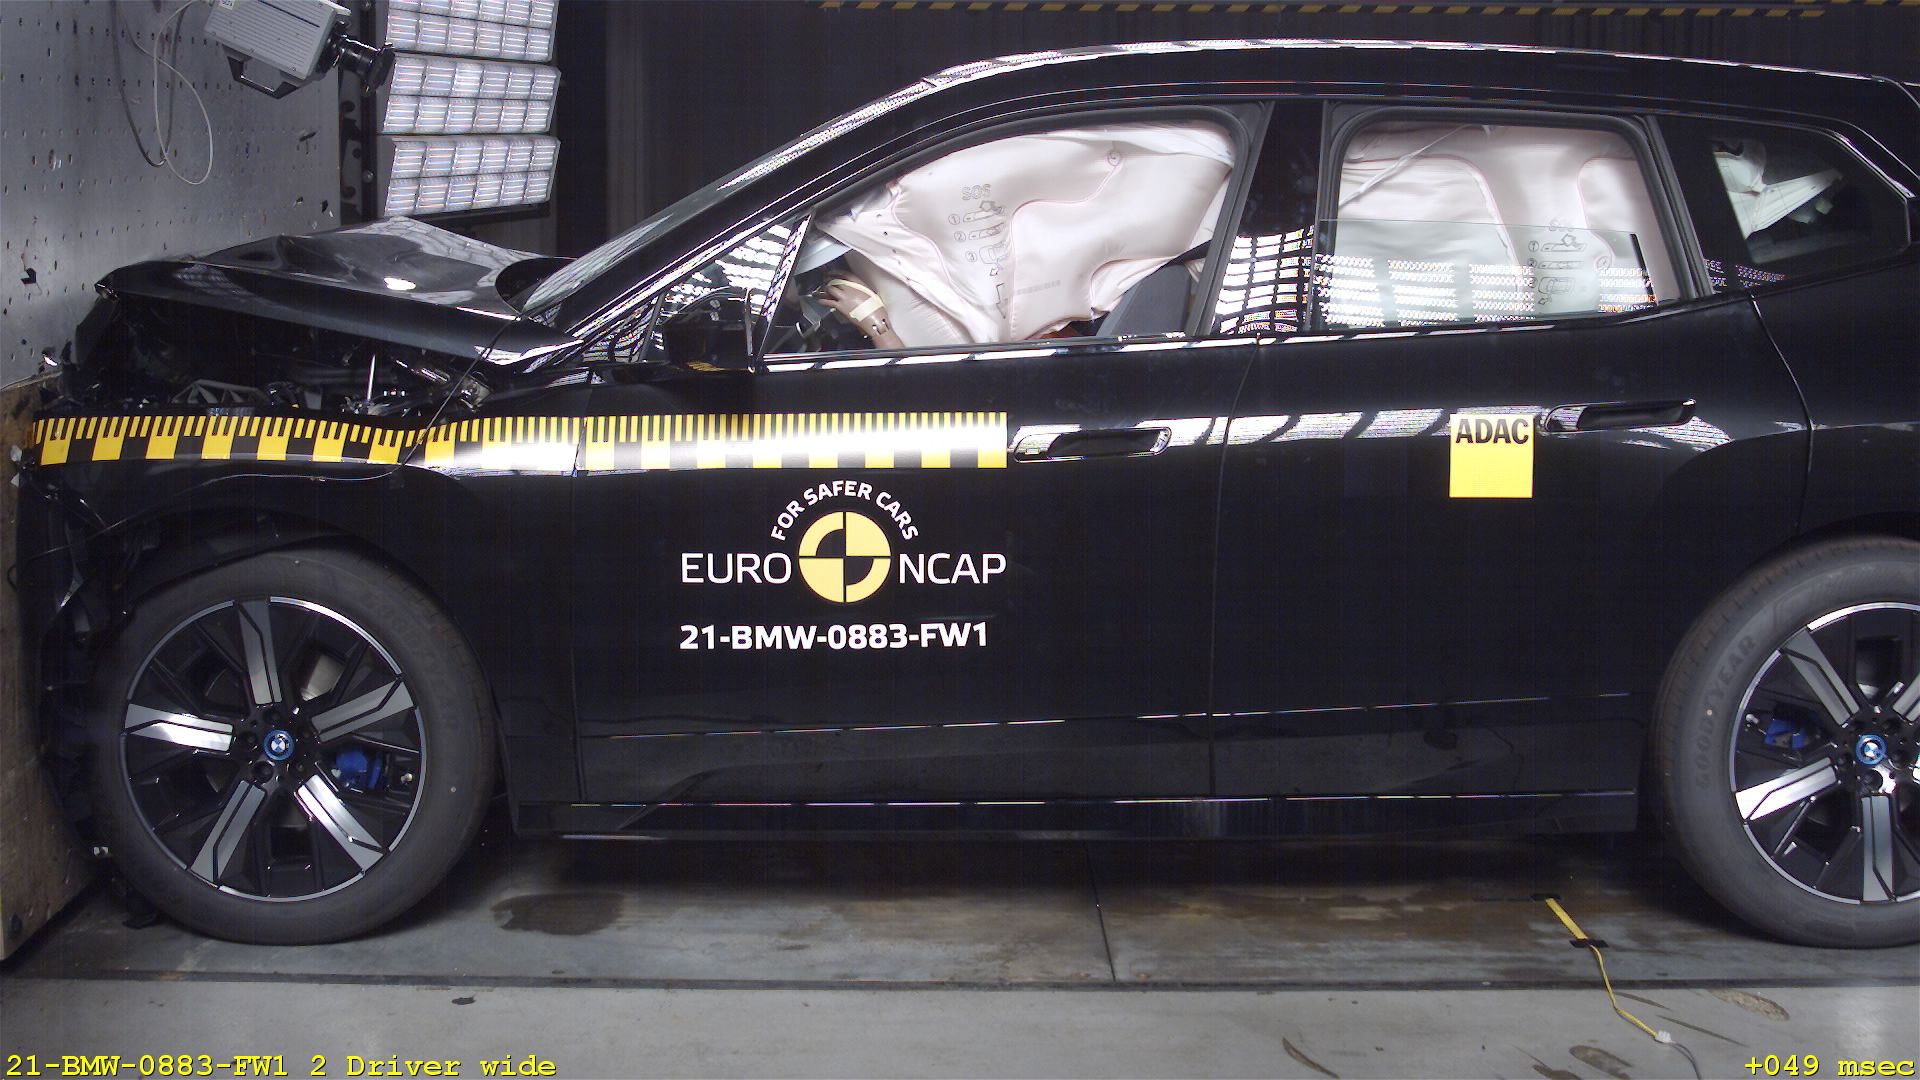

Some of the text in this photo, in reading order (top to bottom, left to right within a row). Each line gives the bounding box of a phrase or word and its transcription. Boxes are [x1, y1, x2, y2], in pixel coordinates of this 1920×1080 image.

[961, 183, 992, 201] SOS
[1455, 418, 1529, 445] ADAC
[770, 480, 919, 541] FOR SAFER CARS
[681, 552, 1007, 584] EURO NCAP
[679, 621, 988, 650] 21-BMW-0883-FW1
